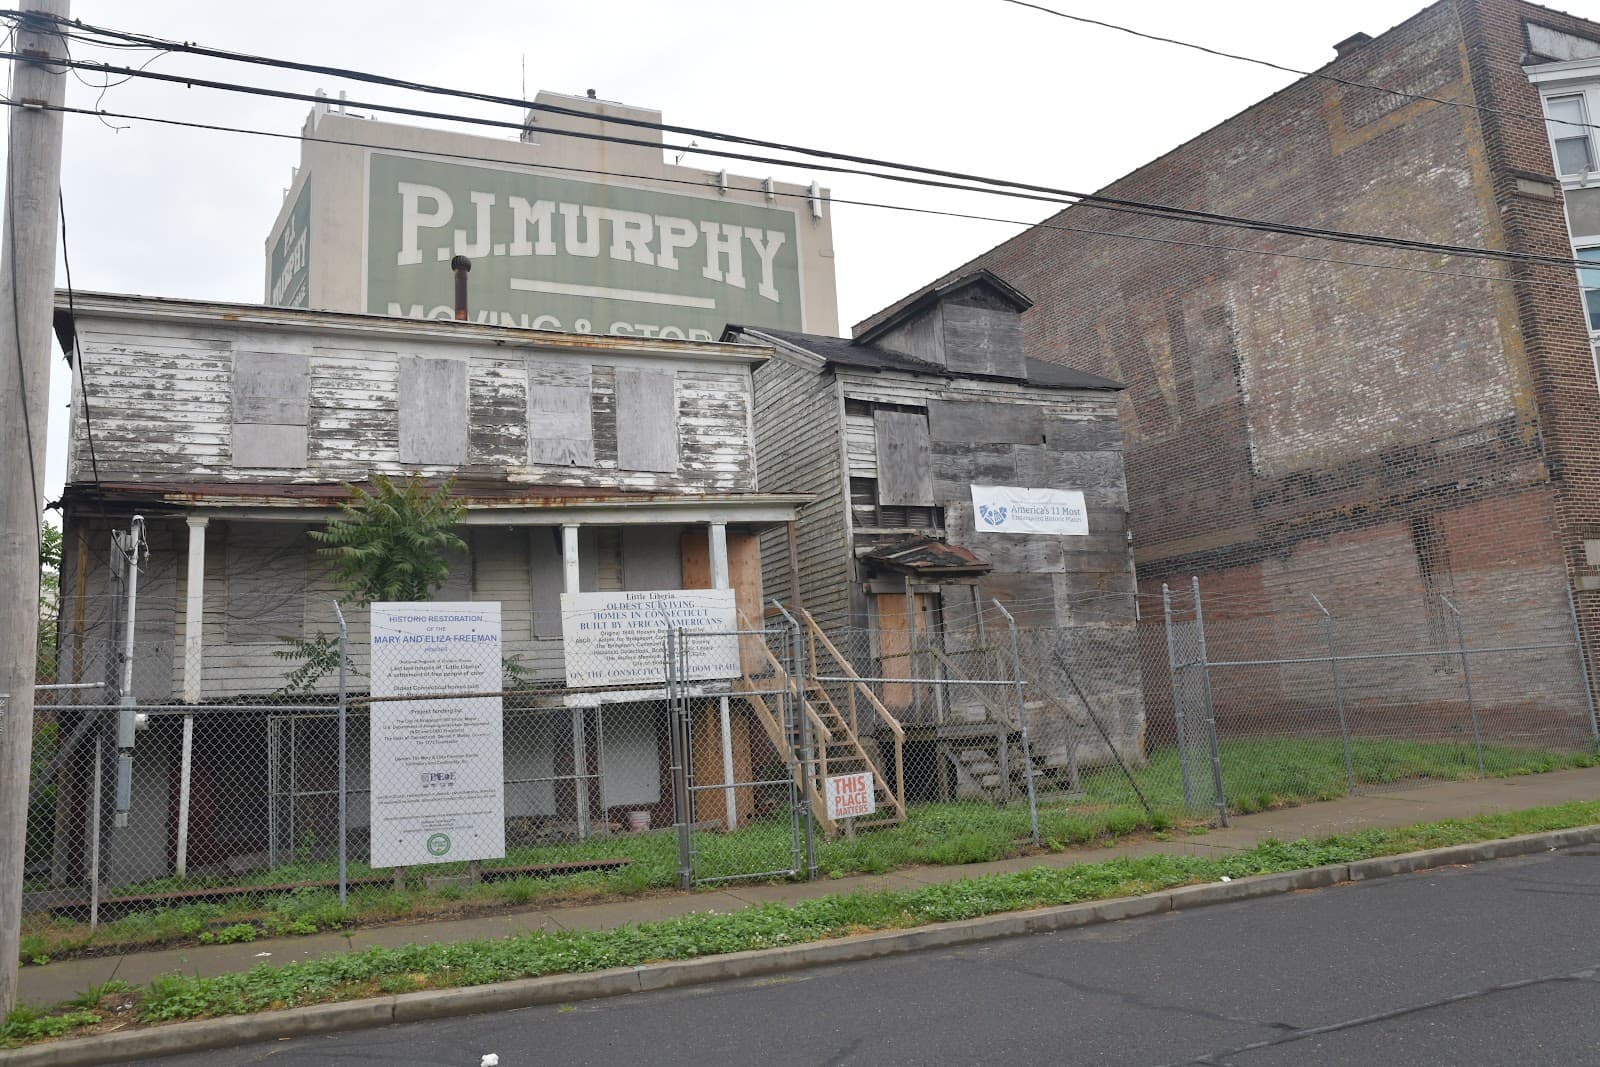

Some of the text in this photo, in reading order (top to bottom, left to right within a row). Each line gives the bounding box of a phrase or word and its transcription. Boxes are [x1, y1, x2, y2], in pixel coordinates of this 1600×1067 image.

[1011, 505, 1050, 515] America's
[1062, 507, 1081, 516] Most
[626, 593, 646, 601] Little
[606, 602, 642, 610] OLDEST
[389, 615, 427, 623] HISTORIC
[593, 609, 708, 620] HOMES IN CONNECTICUT
[580, 618, 723, 630] BUILT BY AFRICAN AMERICANS
[374, 634, 498, 644] MARY AND ELIZA FREEMAN
[833, 776, 866, 795] THIS
[835, 792, 868, 808] PLACE
[835, 804, 868, 817] MATTERS
